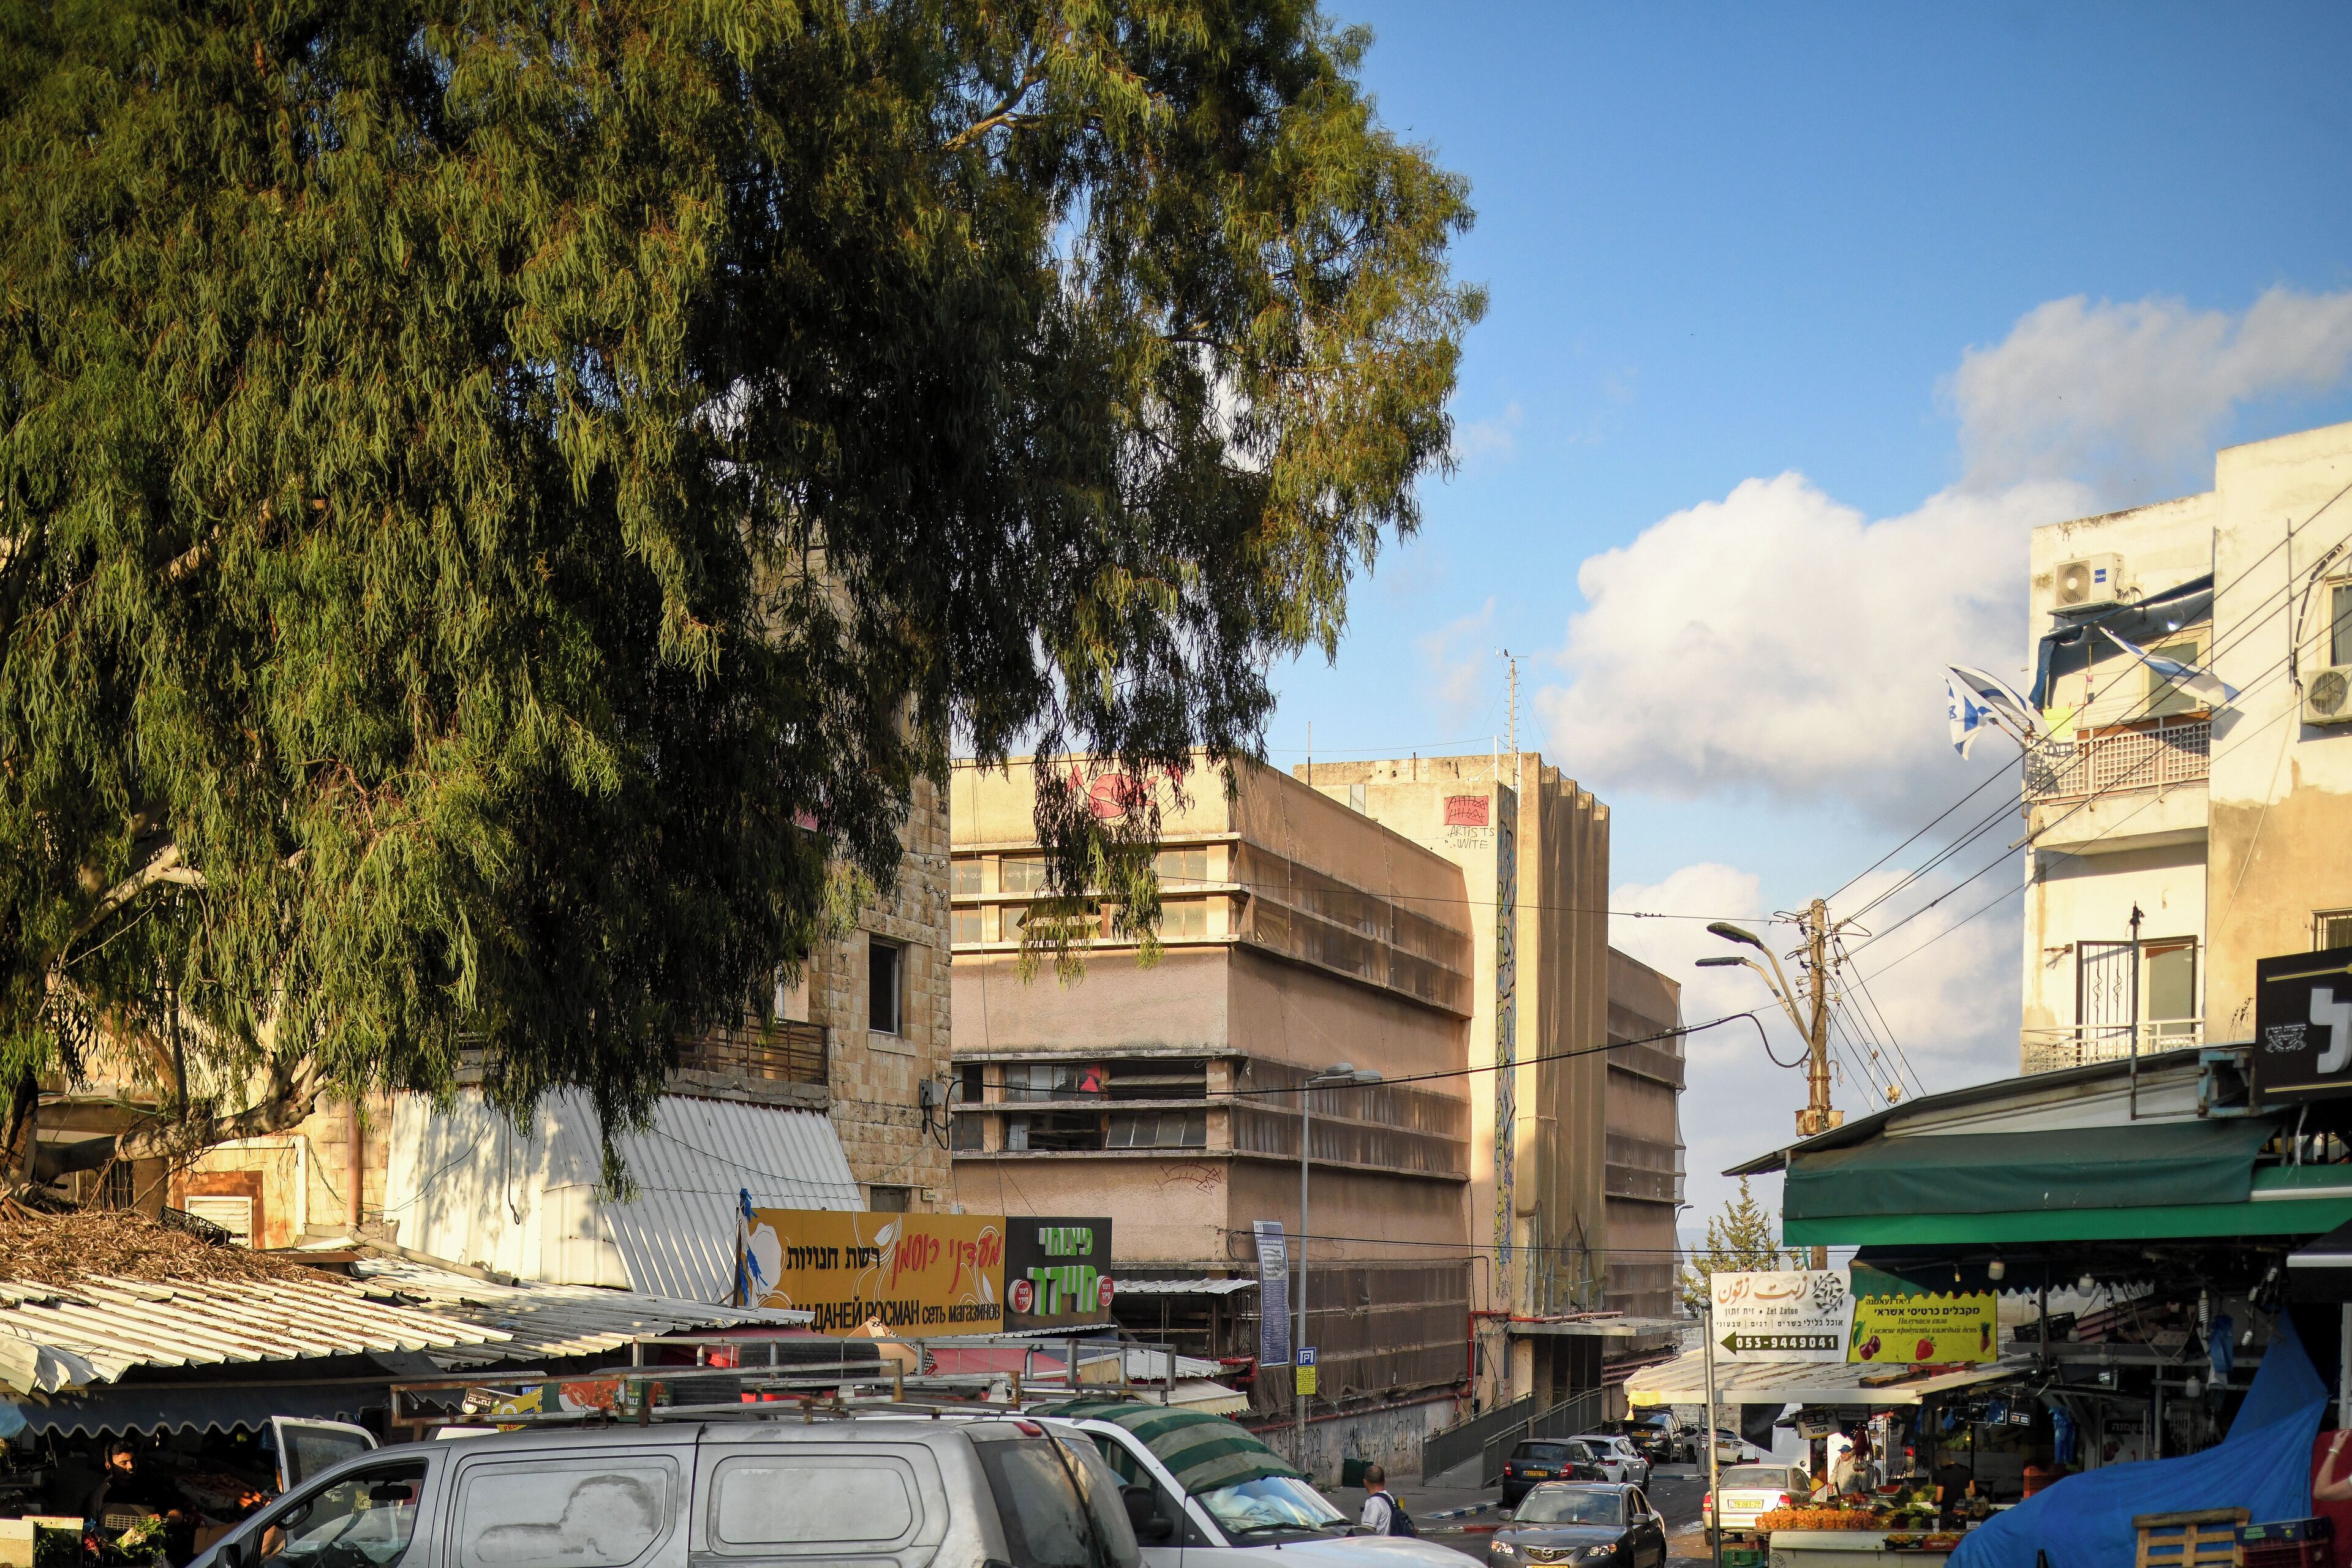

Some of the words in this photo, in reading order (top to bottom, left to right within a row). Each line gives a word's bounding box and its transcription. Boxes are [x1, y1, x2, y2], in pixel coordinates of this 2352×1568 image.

[1039, 1227, 1093, 1256] פיצוחי
[786, 1245, 839, 1270] חנויות
[845, 1246, 881, 1269] רשת
[891, 1233, 940, 1291] רוסמן
[949, 1233, 1003, 1294] מעדני
[1027, 1265, 1098, 1316] חיידר
[865, 1300, 919, 1327] РОСМАН
[922, 1305, 946, 1324] сеть
[948, 1303, 1000, 1323] магазинов
[1803, 1318, 1823, 1327] גלילי
[1825, 1318, 1844, 1327] אוכל
[1874, 1308, 1905, 1316] אשראי
[1942, 1306, 1980, 1316] מקבלים
[1736, 1336, 1835, 1349] 053-9449041
